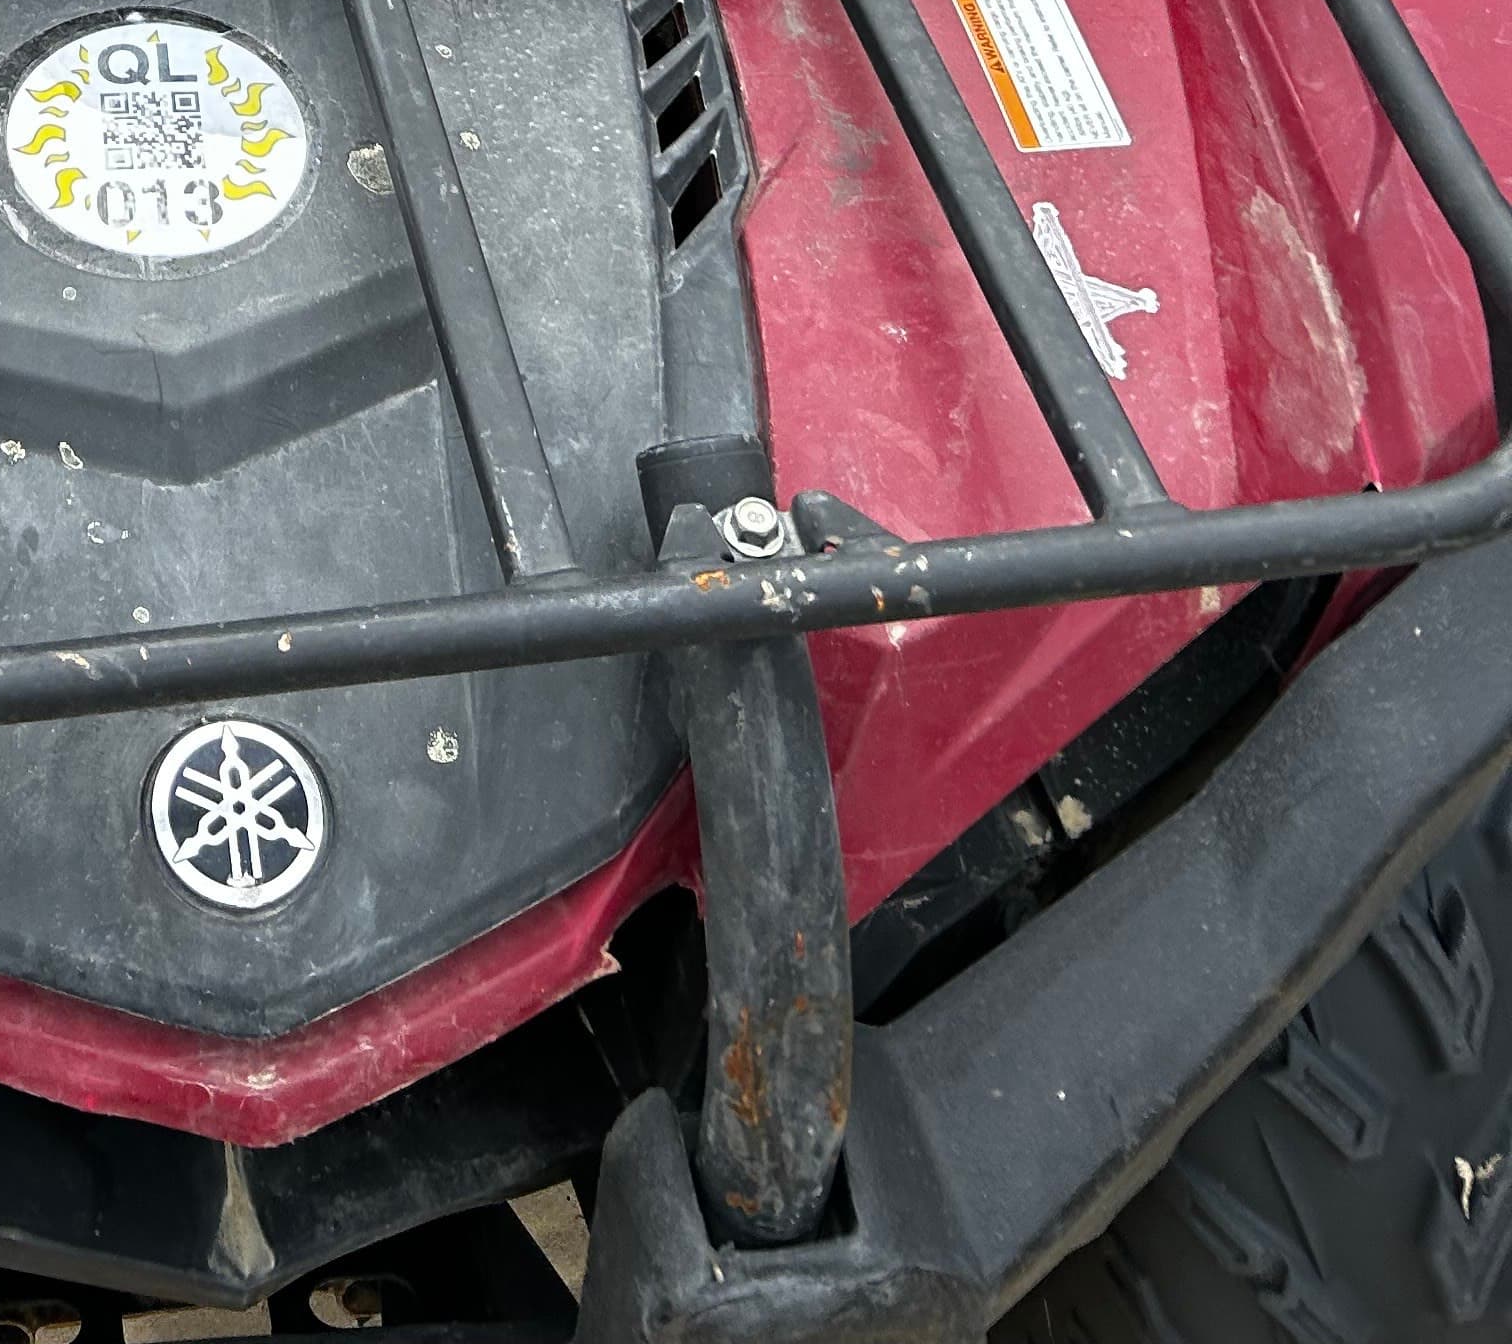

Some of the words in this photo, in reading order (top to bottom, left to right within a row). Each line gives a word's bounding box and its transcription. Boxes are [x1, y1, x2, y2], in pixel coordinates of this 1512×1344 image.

[963, 3, 998, 61] WARNING
[97, 42, 199, 86] QL
[96, 178, 225, 227] 013
